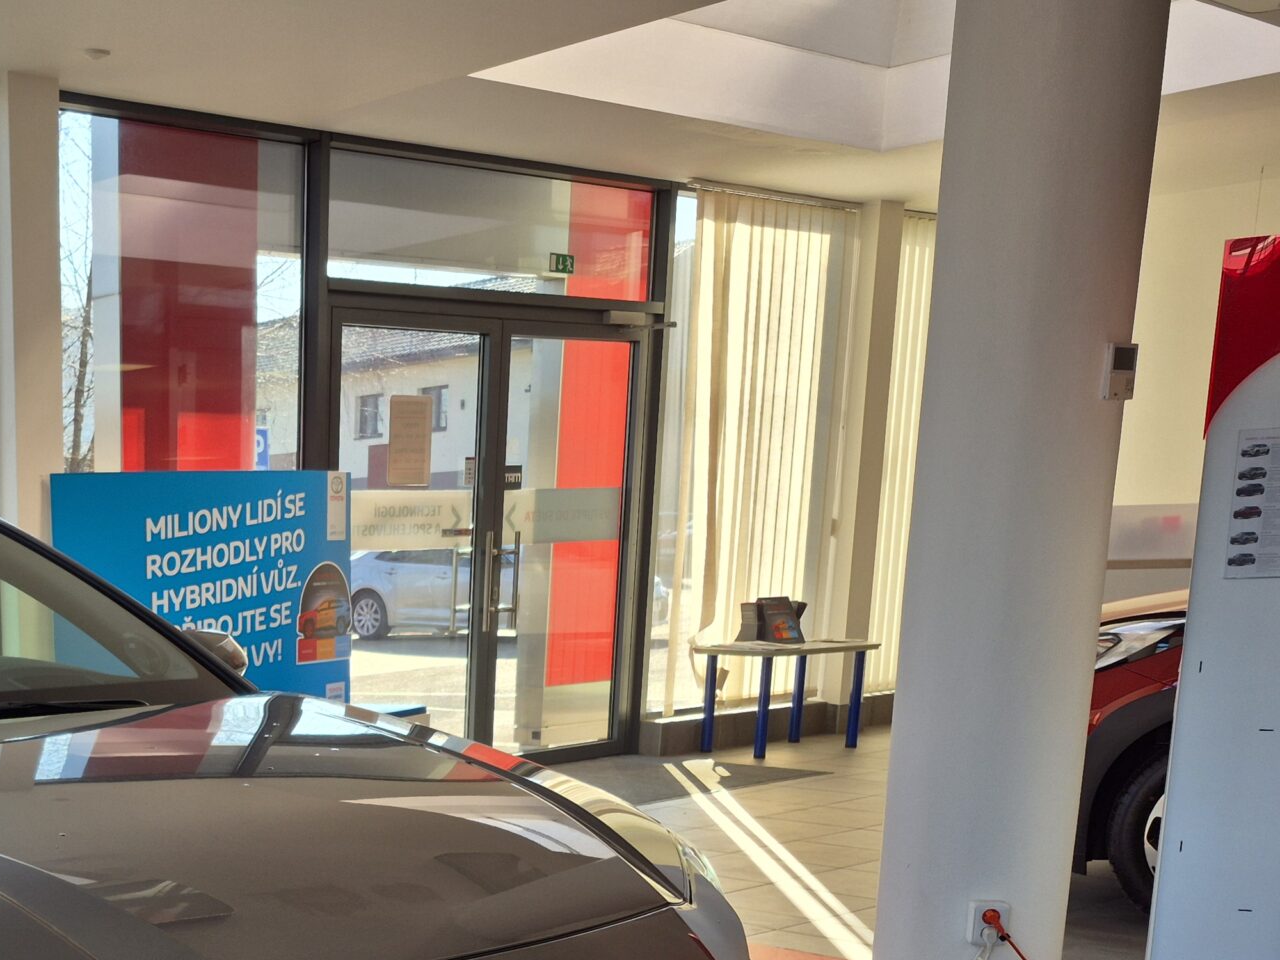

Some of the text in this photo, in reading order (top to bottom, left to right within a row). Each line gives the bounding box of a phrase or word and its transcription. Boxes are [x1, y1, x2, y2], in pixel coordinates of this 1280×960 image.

[146, 489, 305, 542] MILIONY LIDÍ SE
[146, 528, 305, 579] ROZHODLY PRO
[151, 559, 301, 614] HYBRIDNÍ VŮZ.
[269, 601, 292, 628] SE
[251, 638, 282, 667] VY!
